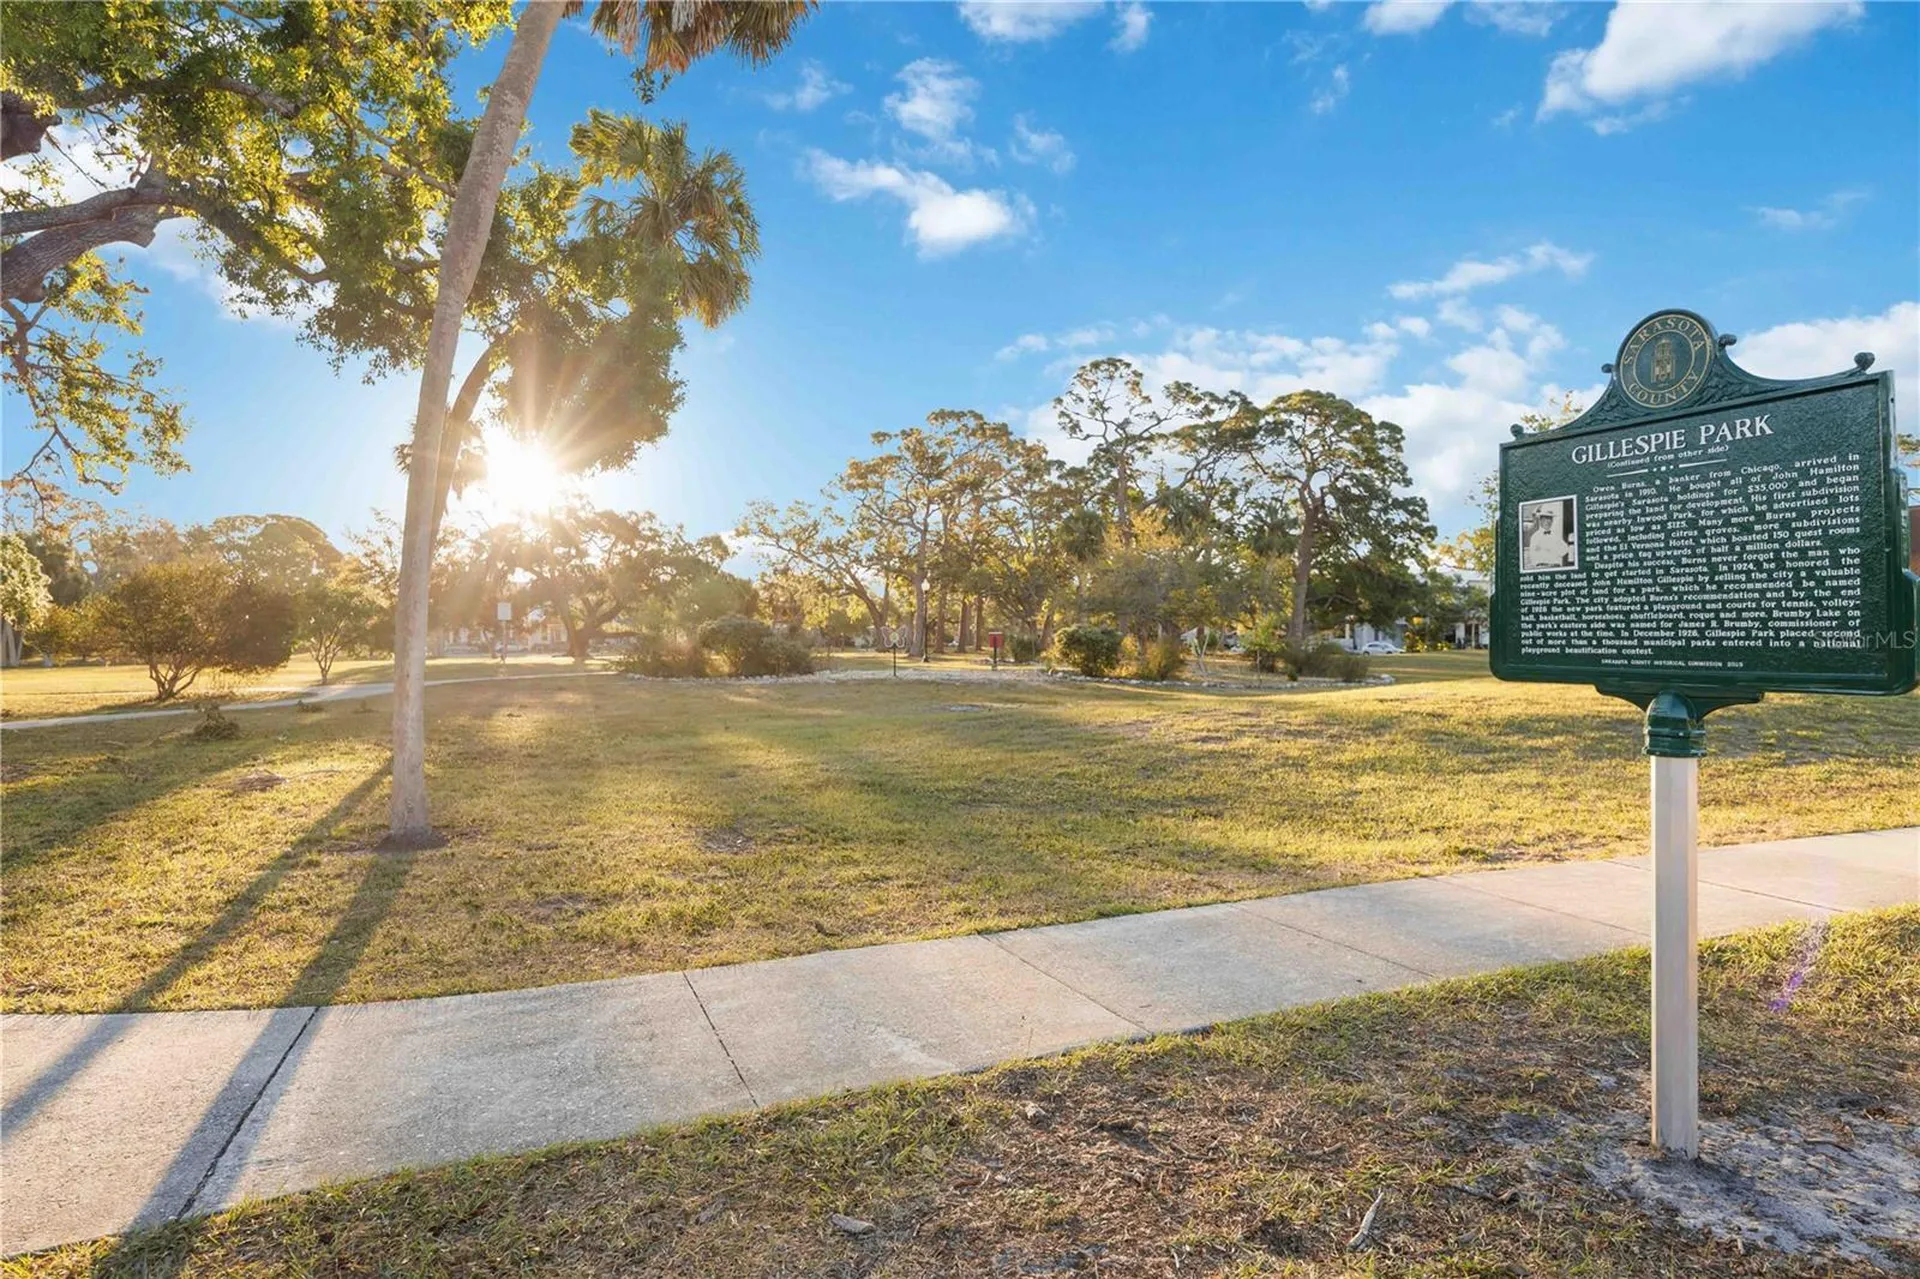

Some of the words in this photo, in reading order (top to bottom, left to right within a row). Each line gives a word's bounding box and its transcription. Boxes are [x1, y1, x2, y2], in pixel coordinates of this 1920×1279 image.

[1623, 318, 1705, 365] SARASOTA
[1628, 370, 1698, 404] COUNTY
[1571, 429, 1687, 464] GILLESPIE
[1698, 414, 1774, 445] PARK
[1654, 453, 1675, 462] from
[1678, 449, 1702, 459] other
[1668, 474, 1700, 483] banker
[1794, 455, 1836, 467] arrived
[1689, 479, 1720, 489] bought
[1772, 470, 1797, 479] John
[1809, 464, 1859, 475] Hamilton
[1676, 491, 1714, 500] holdings
[1798, 478, 1816, 486] and
[1826, 474, 1858, 484] began
[1773, 490, 1795, 499] first
[1801, 484, 1859, 496] subdivision
[1720, 505, 1748, 514] which
[1772, 496, 1828, 509] advertised
[1838, 494, 1859, 502] lots
[1810, 505, 1860, 517] projects
[1791, 516, 1860, 527] subdivisions
[1699, 535, 1726, 544] which
[1731, 532, 1768, 541] boasted
[1794, 528, 1822, 538] guest
[1655, 548, 1691, 557] upwards
[1745, 542, 1779, 550] million
[1742, 552, 1773, 560] forgot
[1785, 558, 1829, 567] honored
[1772, 570, 1793, 578] city
[1814, 567, 1860, 576] valuable
[1723, 580, 1792, 589] recommended
[1824, 577, 1860, 586] named
[1683, 591, 1759, 600] recommendation
[1792, 590, 1805, 598] by
[1652, 602, 1701, 611] playground
[1772, 610, 1811, 618] Brumby
[1780, 629, 1814, 638] placed
